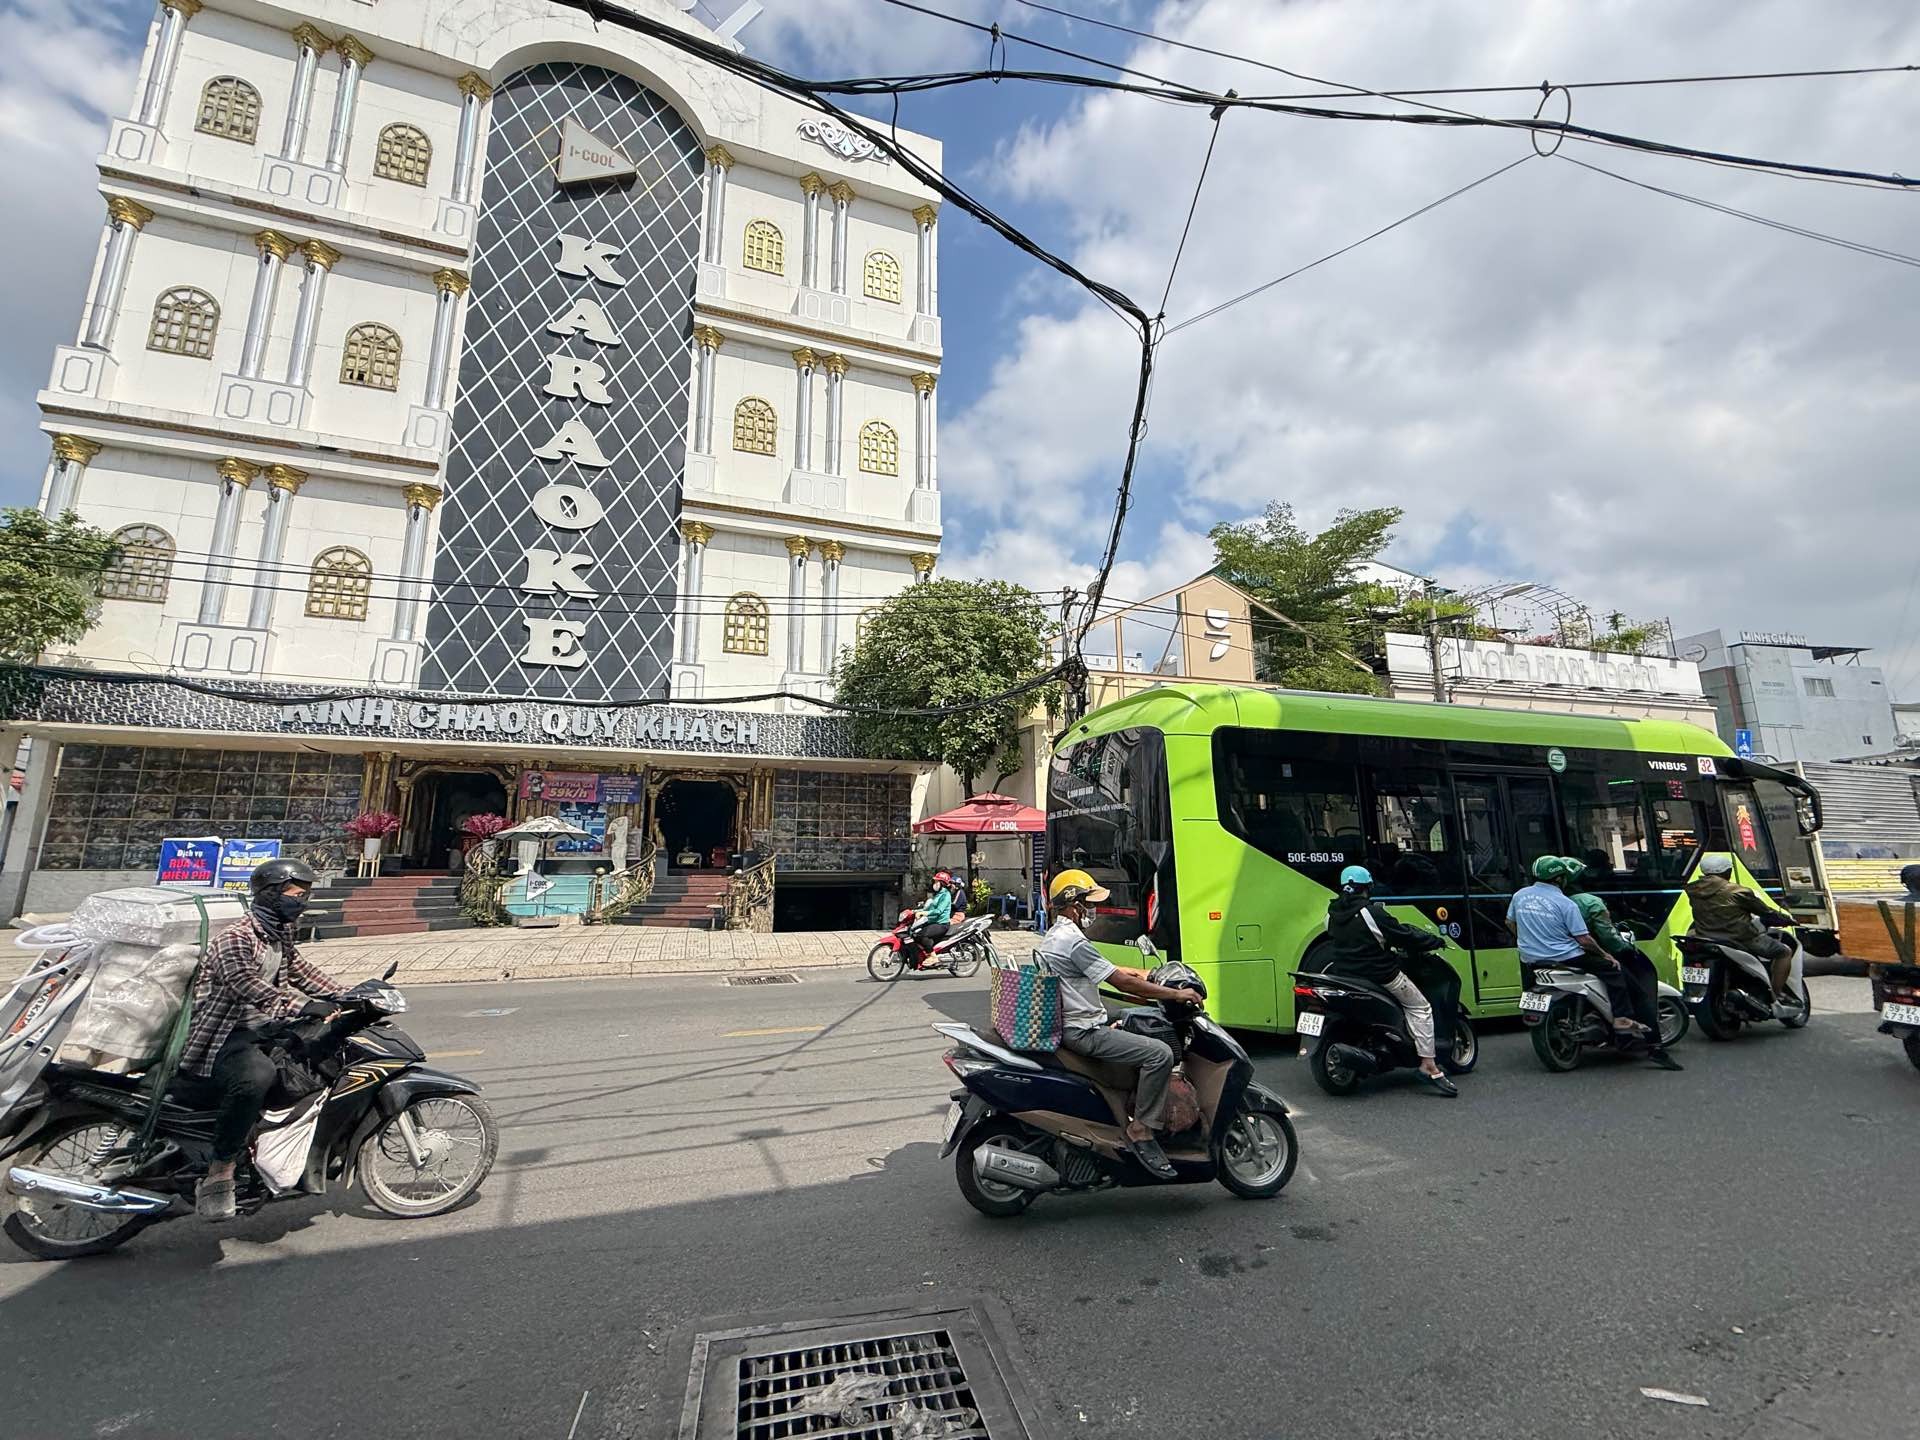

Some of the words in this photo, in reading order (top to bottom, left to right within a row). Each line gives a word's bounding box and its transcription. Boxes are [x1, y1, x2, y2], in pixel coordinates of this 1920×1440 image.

[520, 233, 627, 669] KARAOKE
[635, 713, 758, 745] KHÁCH
[1648, 760, 1688, 771] VINBUS
[1699, 758, 1714, 774] 32
[548, 786, 588, 799] 59k/h
[176, 849, 194, 858] Dịch
[1287, 852, 1345, 863] 50E-650.59
